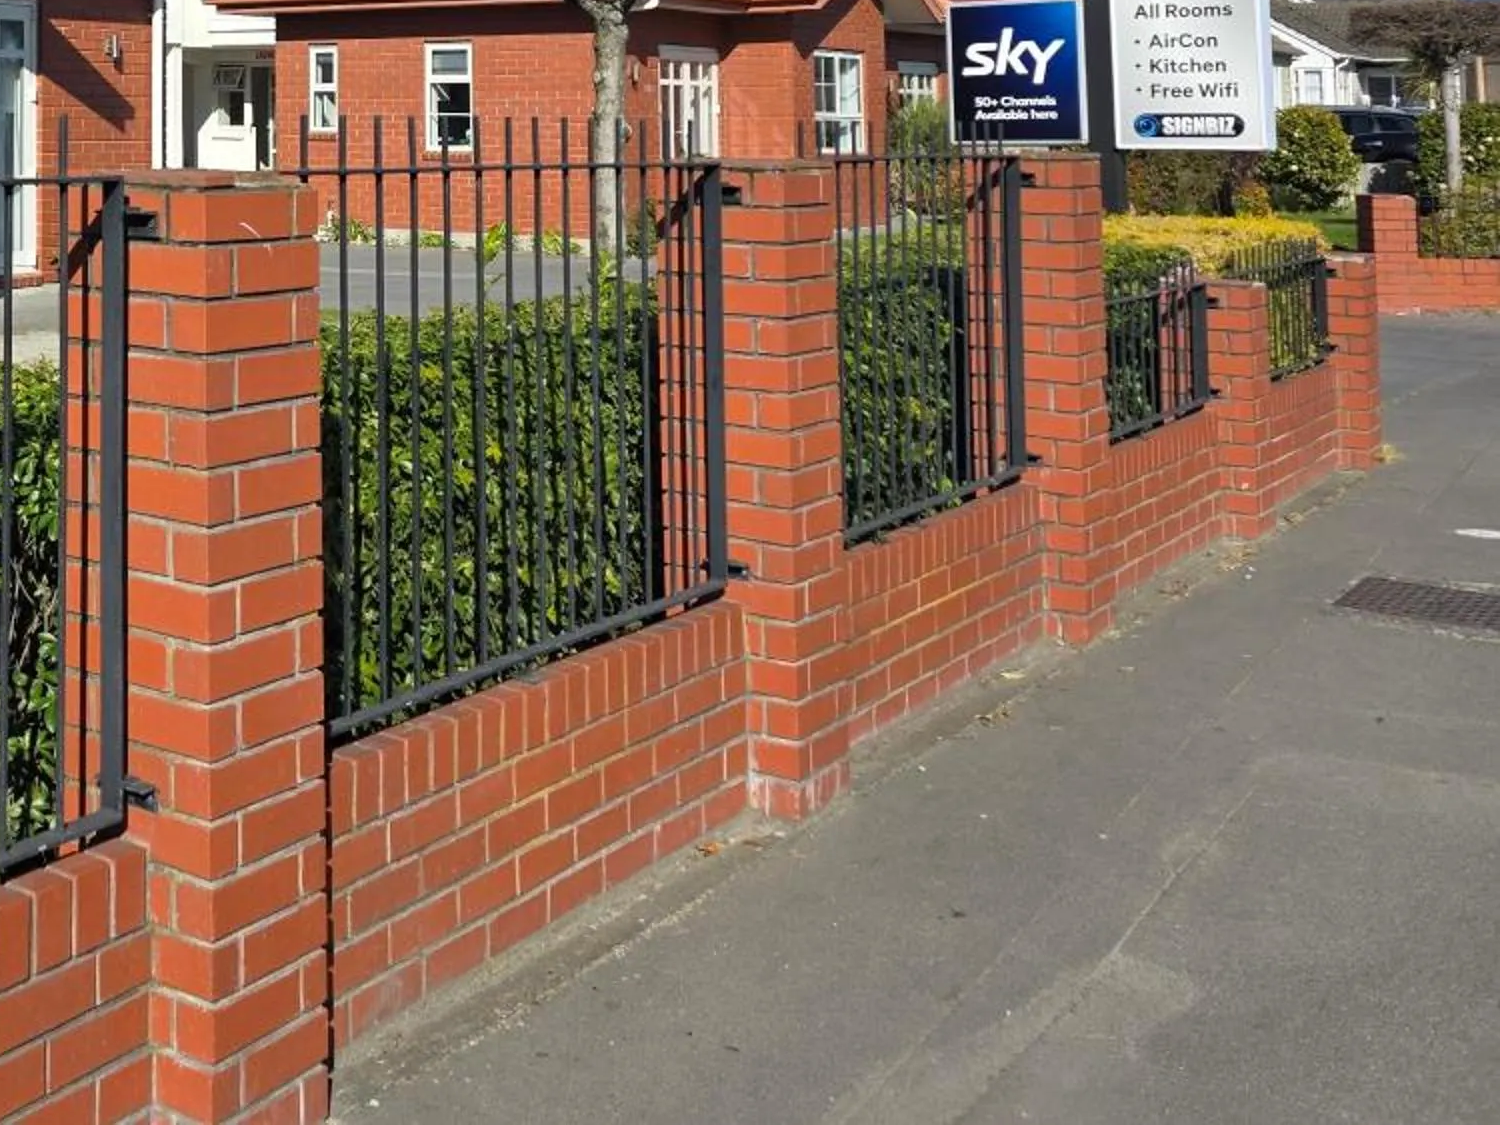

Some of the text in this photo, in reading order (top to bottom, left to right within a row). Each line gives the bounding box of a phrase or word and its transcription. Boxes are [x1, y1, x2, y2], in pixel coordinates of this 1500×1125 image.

[1134, 3, 1233, 19] All Rooms
[1149, 33, 1218, 49] AirCon
[961, 27, 1066, 85] sky
[1149, 58, 1227, 74] Kitchen
[1150, 82, 1239, 99] Free Wifi
[974, 95, 1057, 108] 50+ Channels
[975, 108, 1059, 120] Available here
[1161, 116, 1237, 135] SIGNBIZ
